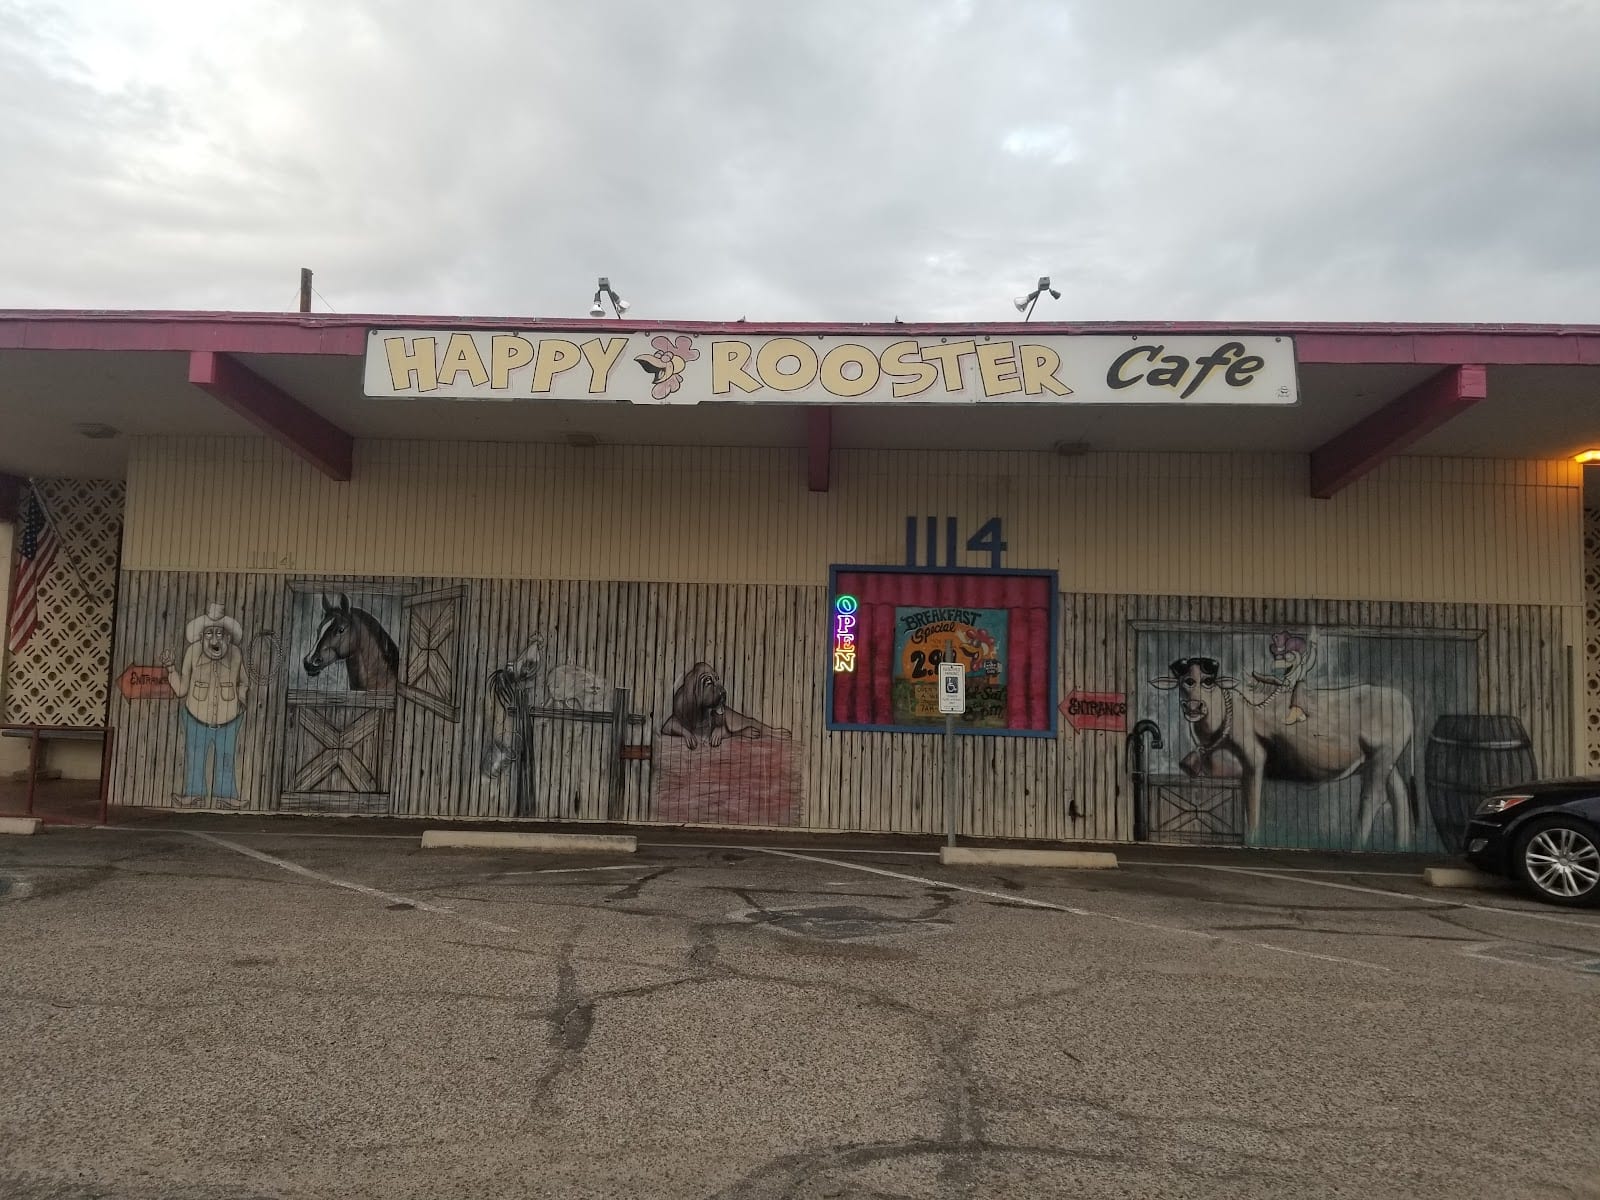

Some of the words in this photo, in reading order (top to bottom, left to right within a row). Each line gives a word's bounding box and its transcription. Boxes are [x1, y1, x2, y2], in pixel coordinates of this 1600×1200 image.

[383, 333, 629, 393] HAPPY
[711, 337, 1074, 397] ROOSTER
[1106, 341, 1265, 400] Cafe
[905, 516, 1008, 569] 1114
[834, 594, 858, 673] OPEN
[901, 609, 981, 633] BREAKFAST
[911, 621, 956, 645] Special
[1068, 697, 1127, 719] ENTRANCE
